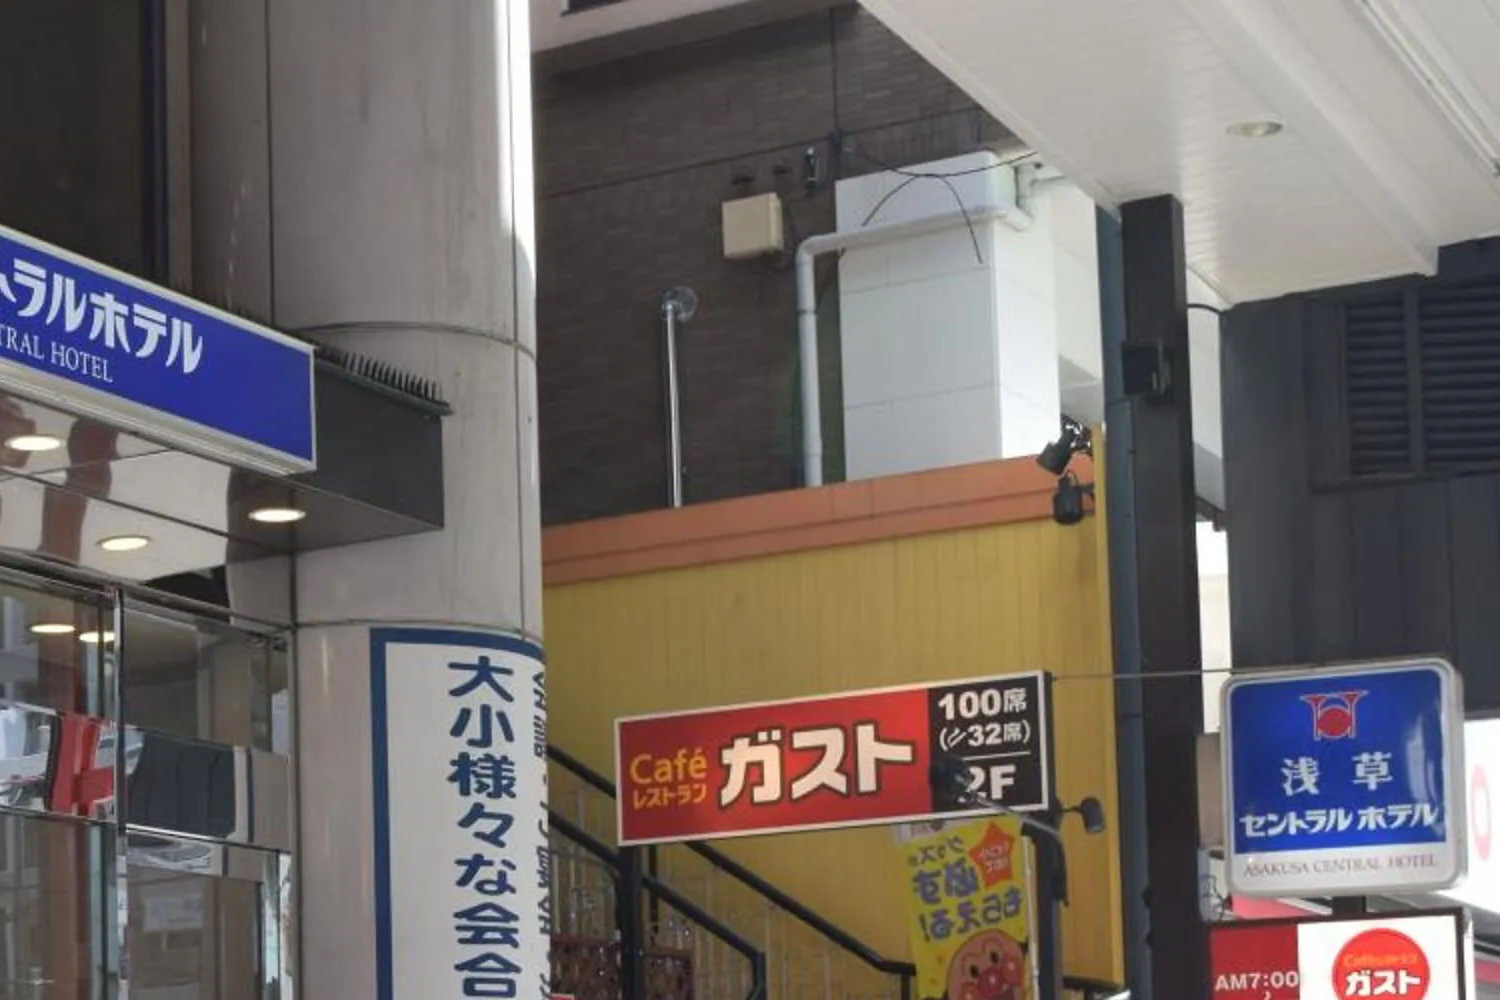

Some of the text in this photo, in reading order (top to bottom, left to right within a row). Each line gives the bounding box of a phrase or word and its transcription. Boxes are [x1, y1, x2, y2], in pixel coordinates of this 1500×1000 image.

[51, 340, 114, 383] HOTEL
[629, 747, 707, 785] Café
[719, 722, 915, 808] ガスト
[632, 783, 707, 810] レストラン
[1313, 857, 1380, 873] CENTRAL
[1386, 852, 1439, 869] HOTEL
[1214, 971, 1299, 992] AM7:00
[1345, 969, 1421, 997] ガスト
